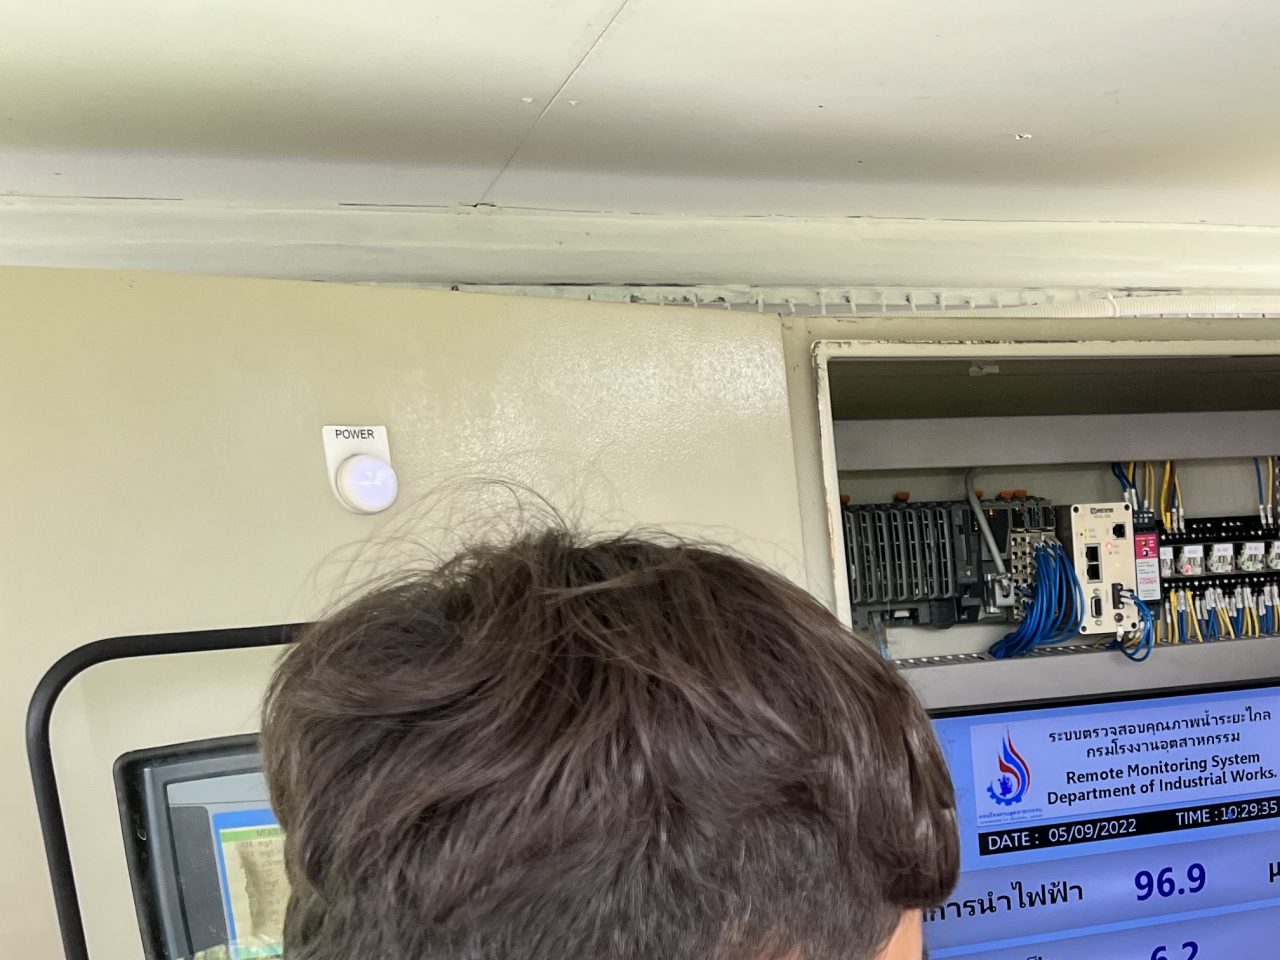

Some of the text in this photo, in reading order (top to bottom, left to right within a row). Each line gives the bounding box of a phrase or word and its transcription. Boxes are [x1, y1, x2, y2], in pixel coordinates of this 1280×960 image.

[335, 429, 375, 439] POWER
[1049, 706, 1271, 744] ระบบตรวจสอบคุณภาพน้ำระยะไกล
[1086, 731, 1240, 759] กรมโรงงานอุตสาหกรรม
[1048, 766, 1278, 806] Department of Industrial Works.
[1066, 752, 1260, 785] Remote Monitoring System
[988, 832, 1031, 851] DATE
[1049, 819, 1137, 843] 05/09/2022
[1176, 810, 1211, 826] TIME
[1134, 862, 1208, 902] 96.9
